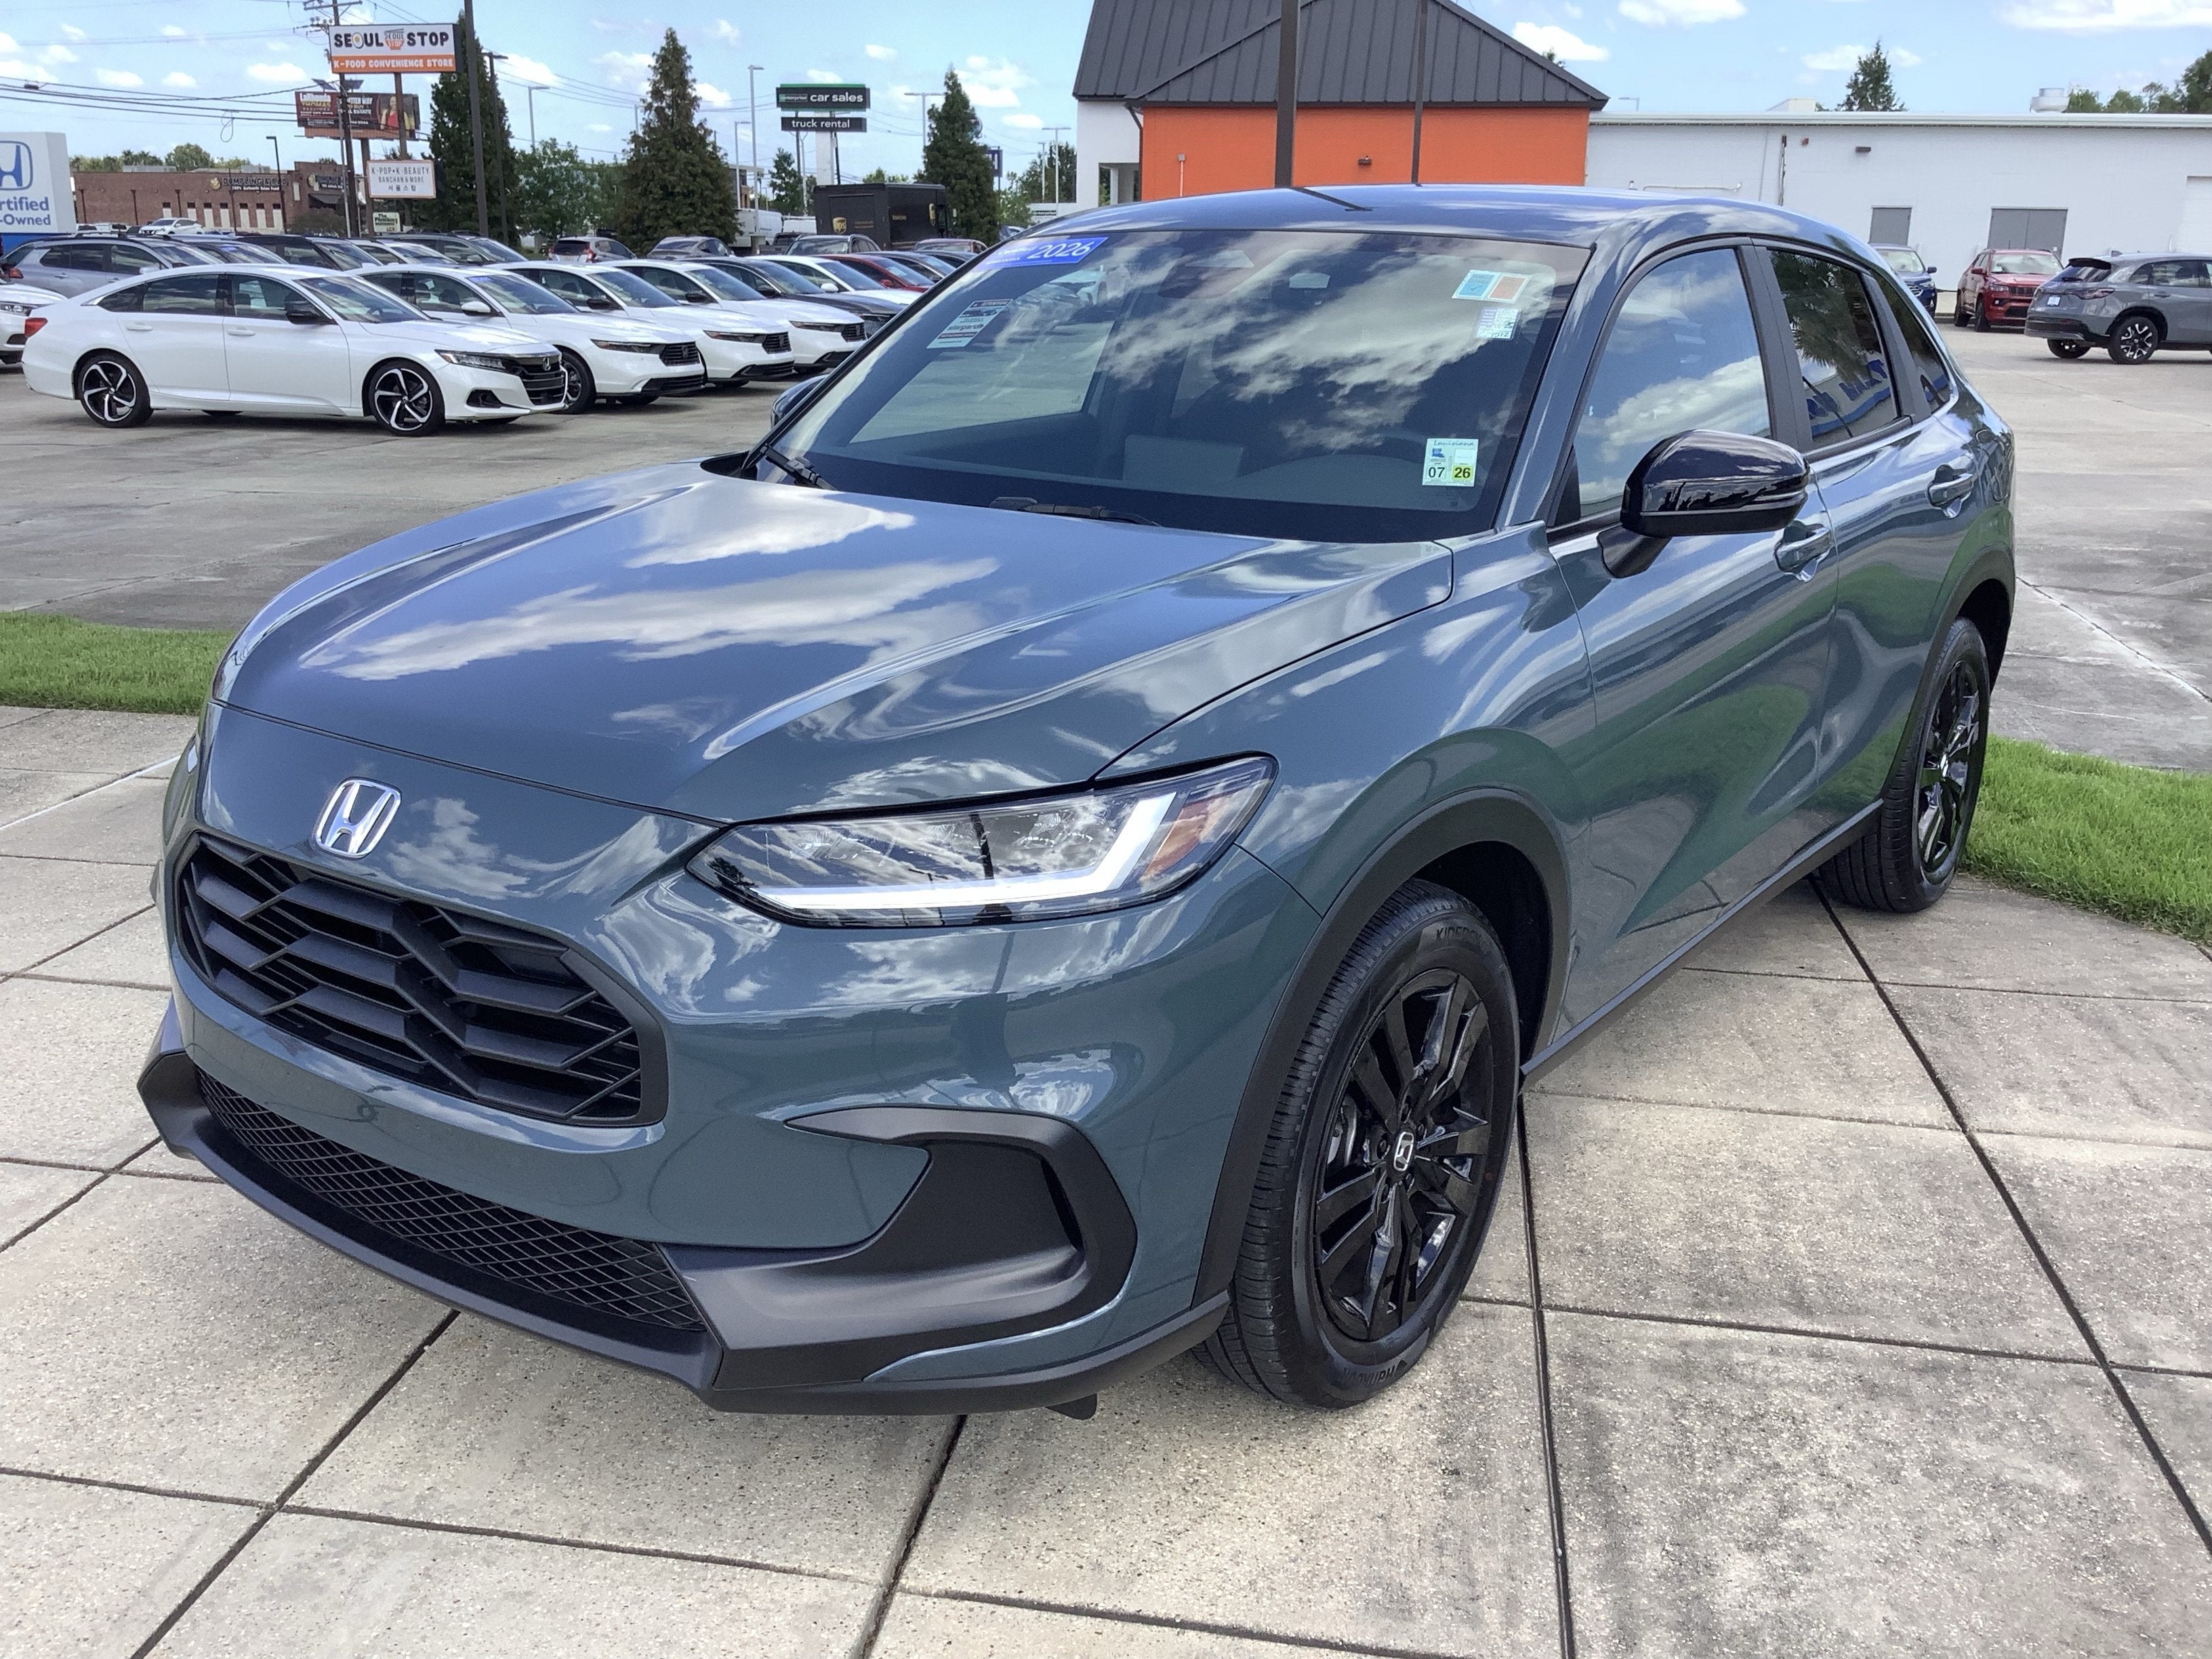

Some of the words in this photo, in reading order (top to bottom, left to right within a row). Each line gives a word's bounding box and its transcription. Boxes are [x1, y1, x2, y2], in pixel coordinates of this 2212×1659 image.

[334, 32, 384, 49] SEOUL
[407, 32, 449, 46] STOP
[333, 60, 366, 68] K-FOOD
[369, 59, 424, 68] CONVENIENCE
[427, 58, 453, 67] STORE
[832, 91, 863, 102] sales
[792, 119, 817, 128] truck
[821, 119, 851, 128] rental
[223, 176, 263, 185] DUMPLING
[271, 177, 288, 186] BAO
[1027, 241, 1095, 260] 2026
[1429, 467, 1446, 478] 07
[1454, 467, 1471, 478] 26
